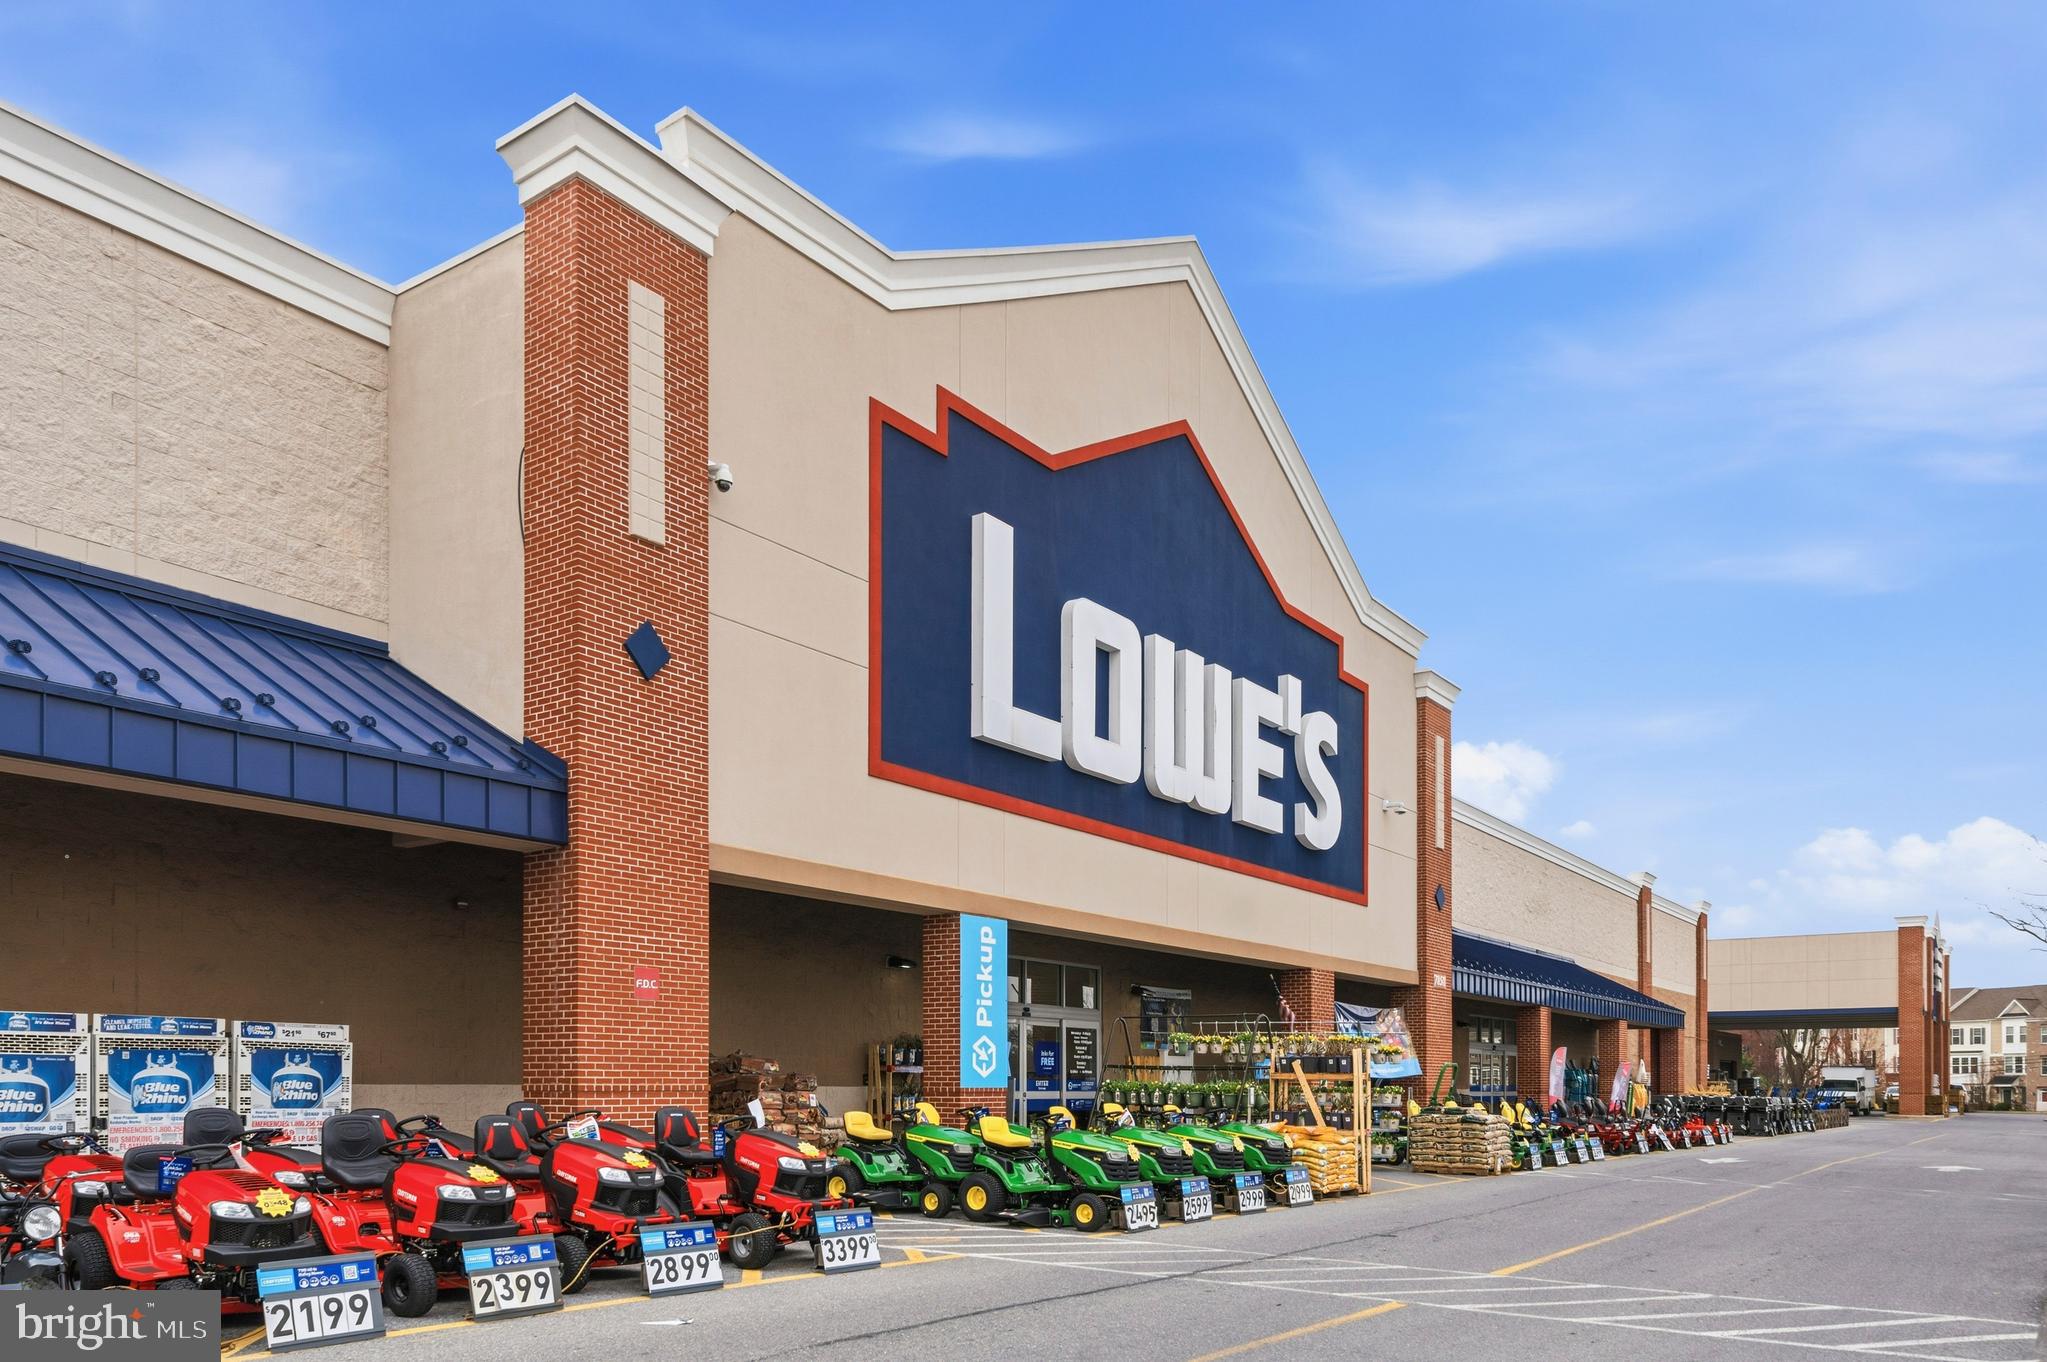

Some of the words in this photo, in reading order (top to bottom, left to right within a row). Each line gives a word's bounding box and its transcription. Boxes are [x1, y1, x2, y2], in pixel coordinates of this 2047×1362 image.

[970, 512, 1342, 851] LOWE'S
[976, 926, 996, 1027] Pickup
[636, 979, 658, 989] F.D.C.
[1041, 1057, 1055, 1066] FREE
[145, 1082, 180, 1093] Blue
[282, 1079, 313, 1090] Blue
[139, 1093, 187, 1105] Rhino
[279, 1089, 319, 1101] Rhino
[1240, 1191, 1263, 1208] 2999
[1127, 1205, 1156, 1224] 2495
